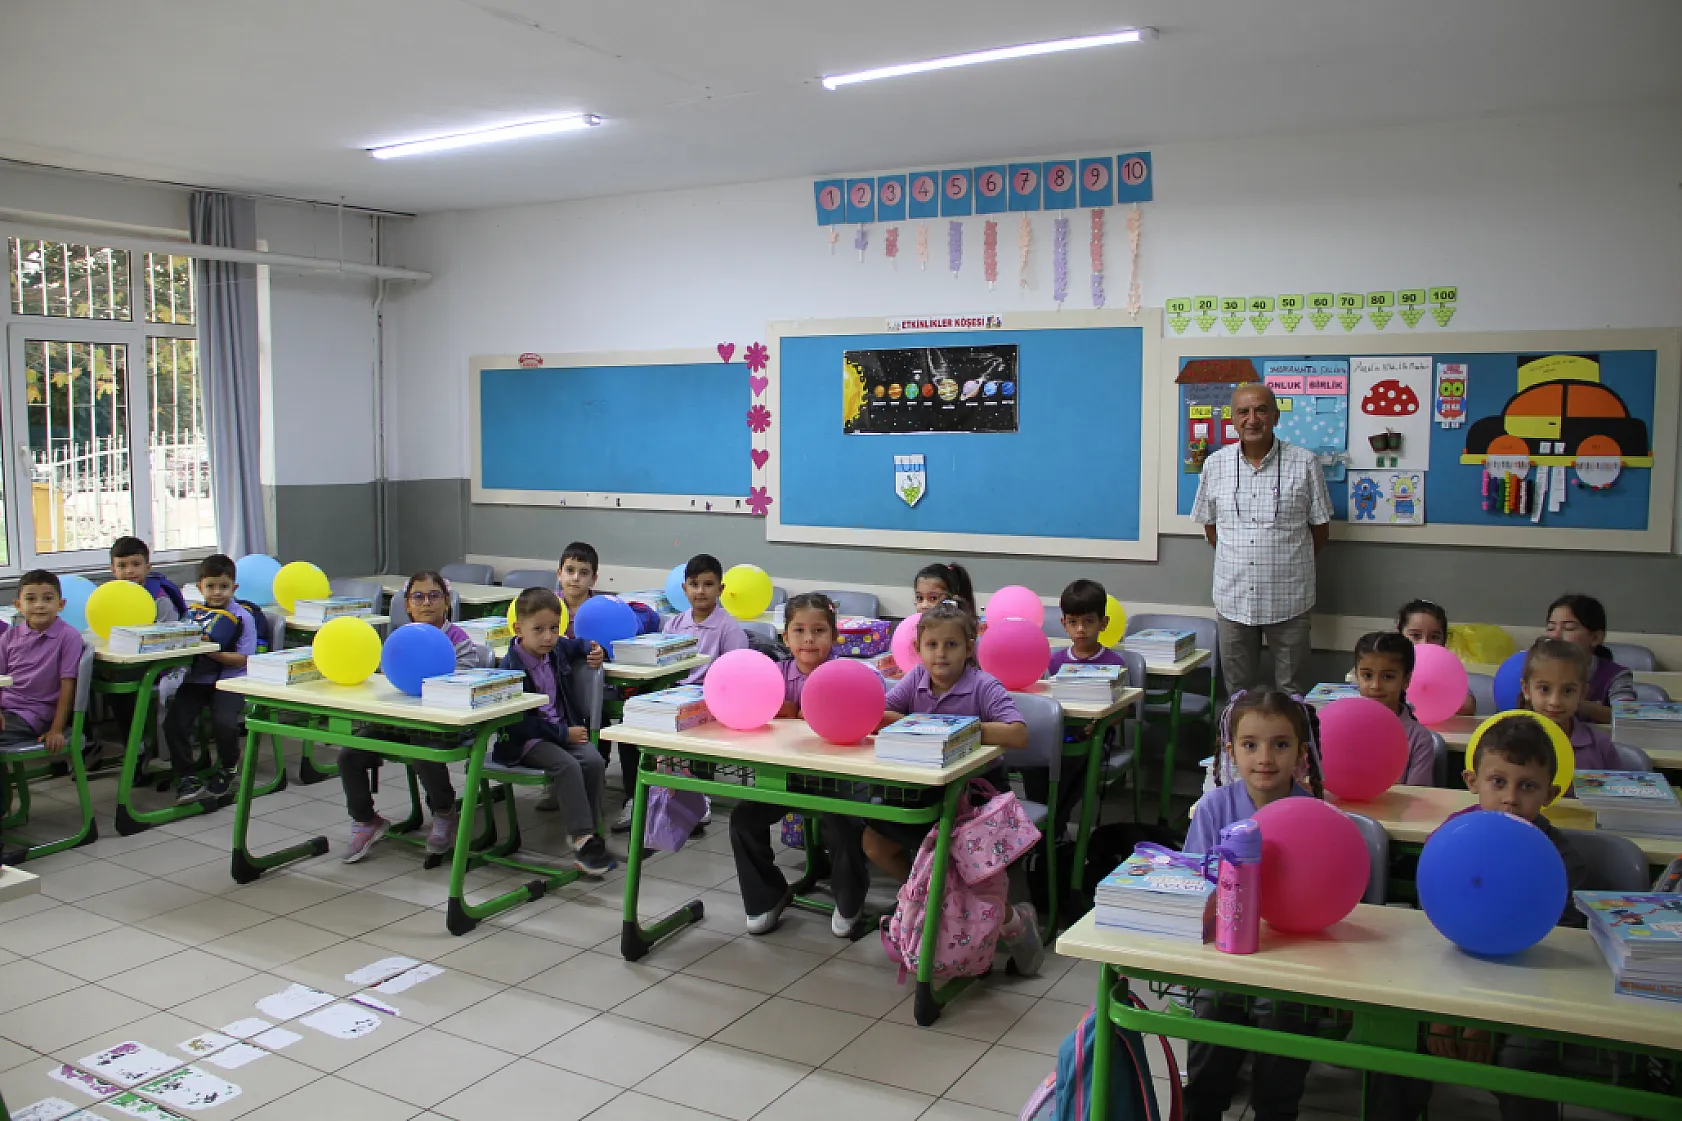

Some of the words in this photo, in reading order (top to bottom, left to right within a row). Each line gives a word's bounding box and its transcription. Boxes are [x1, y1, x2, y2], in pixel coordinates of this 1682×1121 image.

[826, 189, 835, 207] 1
[857, 187, 866, 204] 2
[886, 184, 896, 202] 3
[918, 179, 930, 197] 4
[951, 177, 962, 196] 5
[986, 174, 997, 192] 6
[1019, 172, 1030, 191] 7
[1054, 169, 1065, 187] 8
[1091, 167, 1101, 187] 9
[1124, 161, 1144, 181] 10
[1171, 303, 1184, 311] 10
[1199, 300, 1212, 309] 20
[1223, 301, 1238, 310] 30
[1252, 301, 1266, 310] 40
[1282, 298, 1295, 307] 50
[1313, 298, 1328, 307] 60
[1341, 297, 1355, 306] 70
[1370, 295, 1385, 305] 80
[1402, 293, 1416, 303] 90
[1433, 290, 1456, 300] 100
[901, 317, 953, 330] ETKİNLİKLER
[954, 315, 985, 329] KÖŞESİ
[1267, 381, 1301, 389] ONLUK
[1309, 379, 1343, 389] BİRLİK
